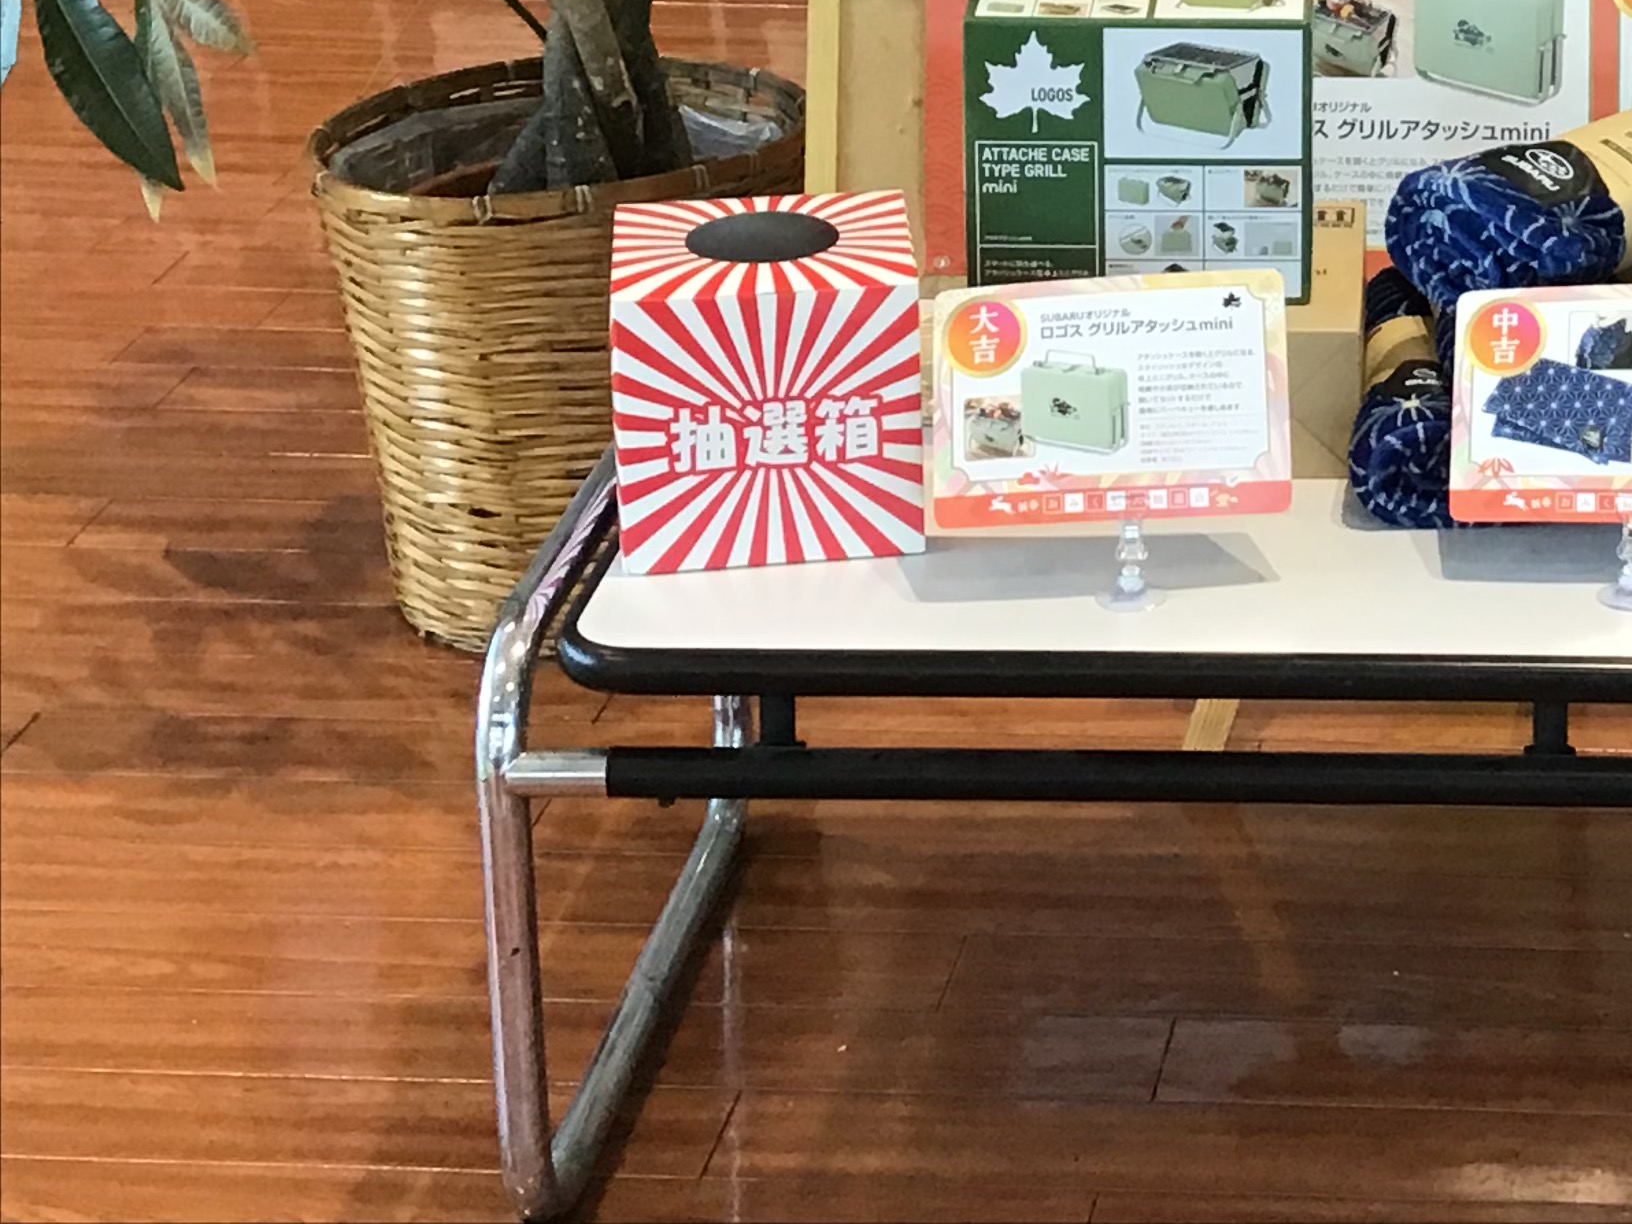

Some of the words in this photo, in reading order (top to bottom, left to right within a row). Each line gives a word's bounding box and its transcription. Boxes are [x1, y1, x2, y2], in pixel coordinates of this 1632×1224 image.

[1031, 87, 1073, 102] LOGOS
[1314, 101, 1372, 114] オリジナル
[1338, 119, 1551, 142] グリルアタッシュmini
[982, 147, 1048, 162] ATTACHE
[1051, 148, 1090, 163] CASE
[982, 163, 1021, 178] TYPE
[1024, 164, 1067, 178] GRILL
[1501, 154, 1560, 192] SUBARU
[982, 181, 1018, 194] mini
[1040, 308, 1131, 323] SUBARUオリジナル
[969, 305, 999, 364] 大吉
[1040, 323, 1083, 339] ロゴス
[1088, 316, 1234, 336] グリルアタッシュmini
[1490, 308, 1520, 364] 中吉
[670, 395, 879, 473] 抽選箱
